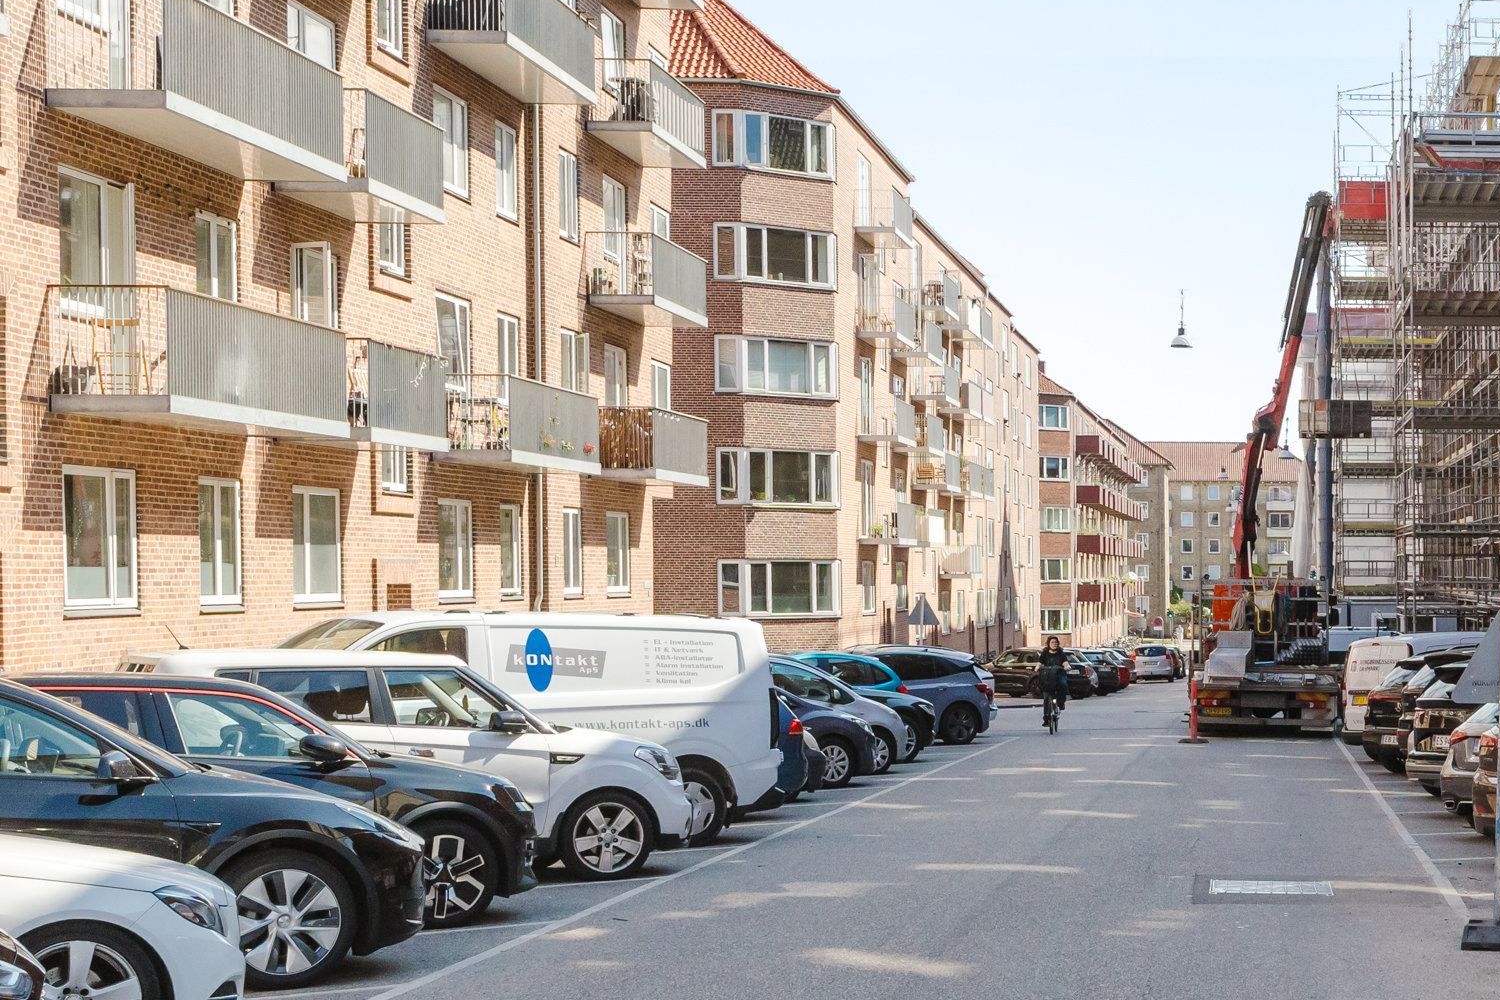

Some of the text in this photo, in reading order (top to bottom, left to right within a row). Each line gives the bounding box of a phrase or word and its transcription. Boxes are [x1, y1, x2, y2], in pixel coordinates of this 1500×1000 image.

[669, 639, 714, 647] Installation
[680, 662, 724, 670] installation
[579, 666, 599, 675] ApS
[574, 718, 710, 731] www.kontakt-aps.dk
